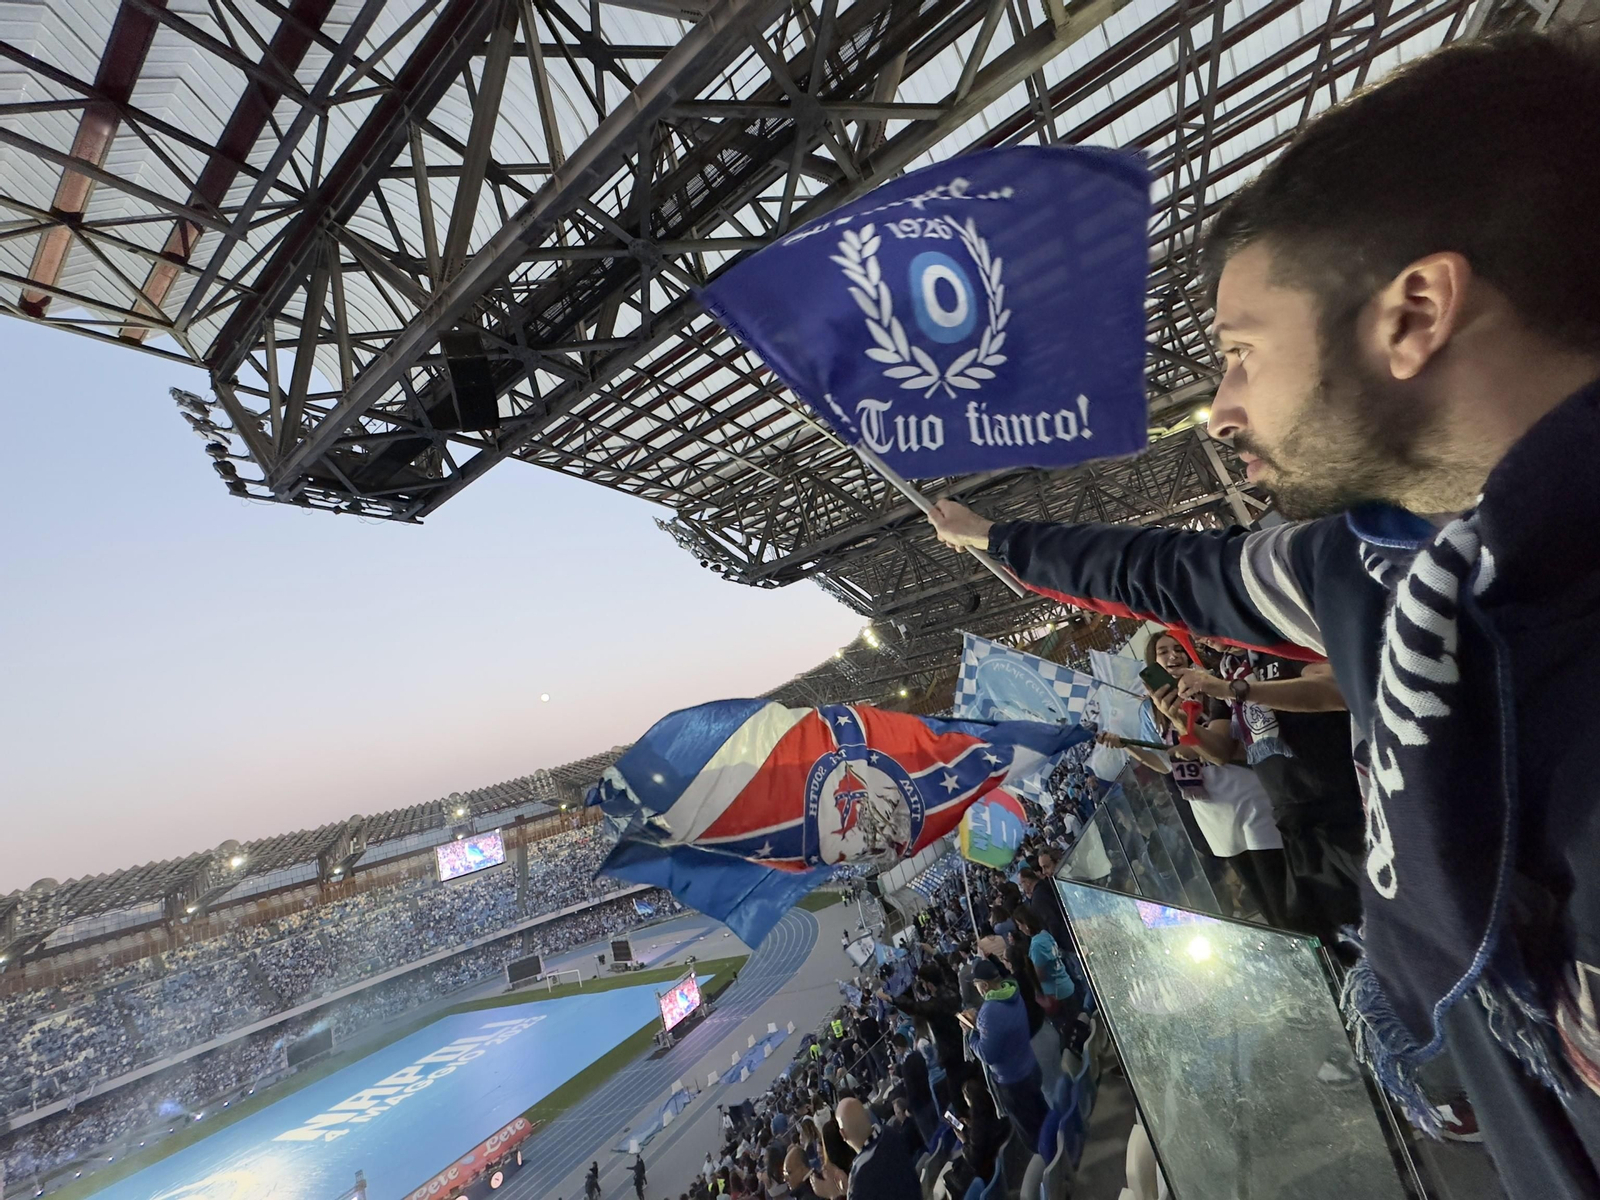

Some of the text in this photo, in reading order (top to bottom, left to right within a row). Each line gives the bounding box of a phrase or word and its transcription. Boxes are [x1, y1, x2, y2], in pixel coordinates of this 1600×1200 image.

[884, 217, 953, 240] 1926
[855, 398, 944, 454] Tuo
[965, 393, 1093, 447] fianco!
[1175, 762, 1200, 779] 19
[271, 1018, 527, 1142] NAPOLI
[324, 1128, 350, 1142] 4
[348, 1050, 486, 1123] MAGGIO
[483, 1118, 525, 1157] Lete
